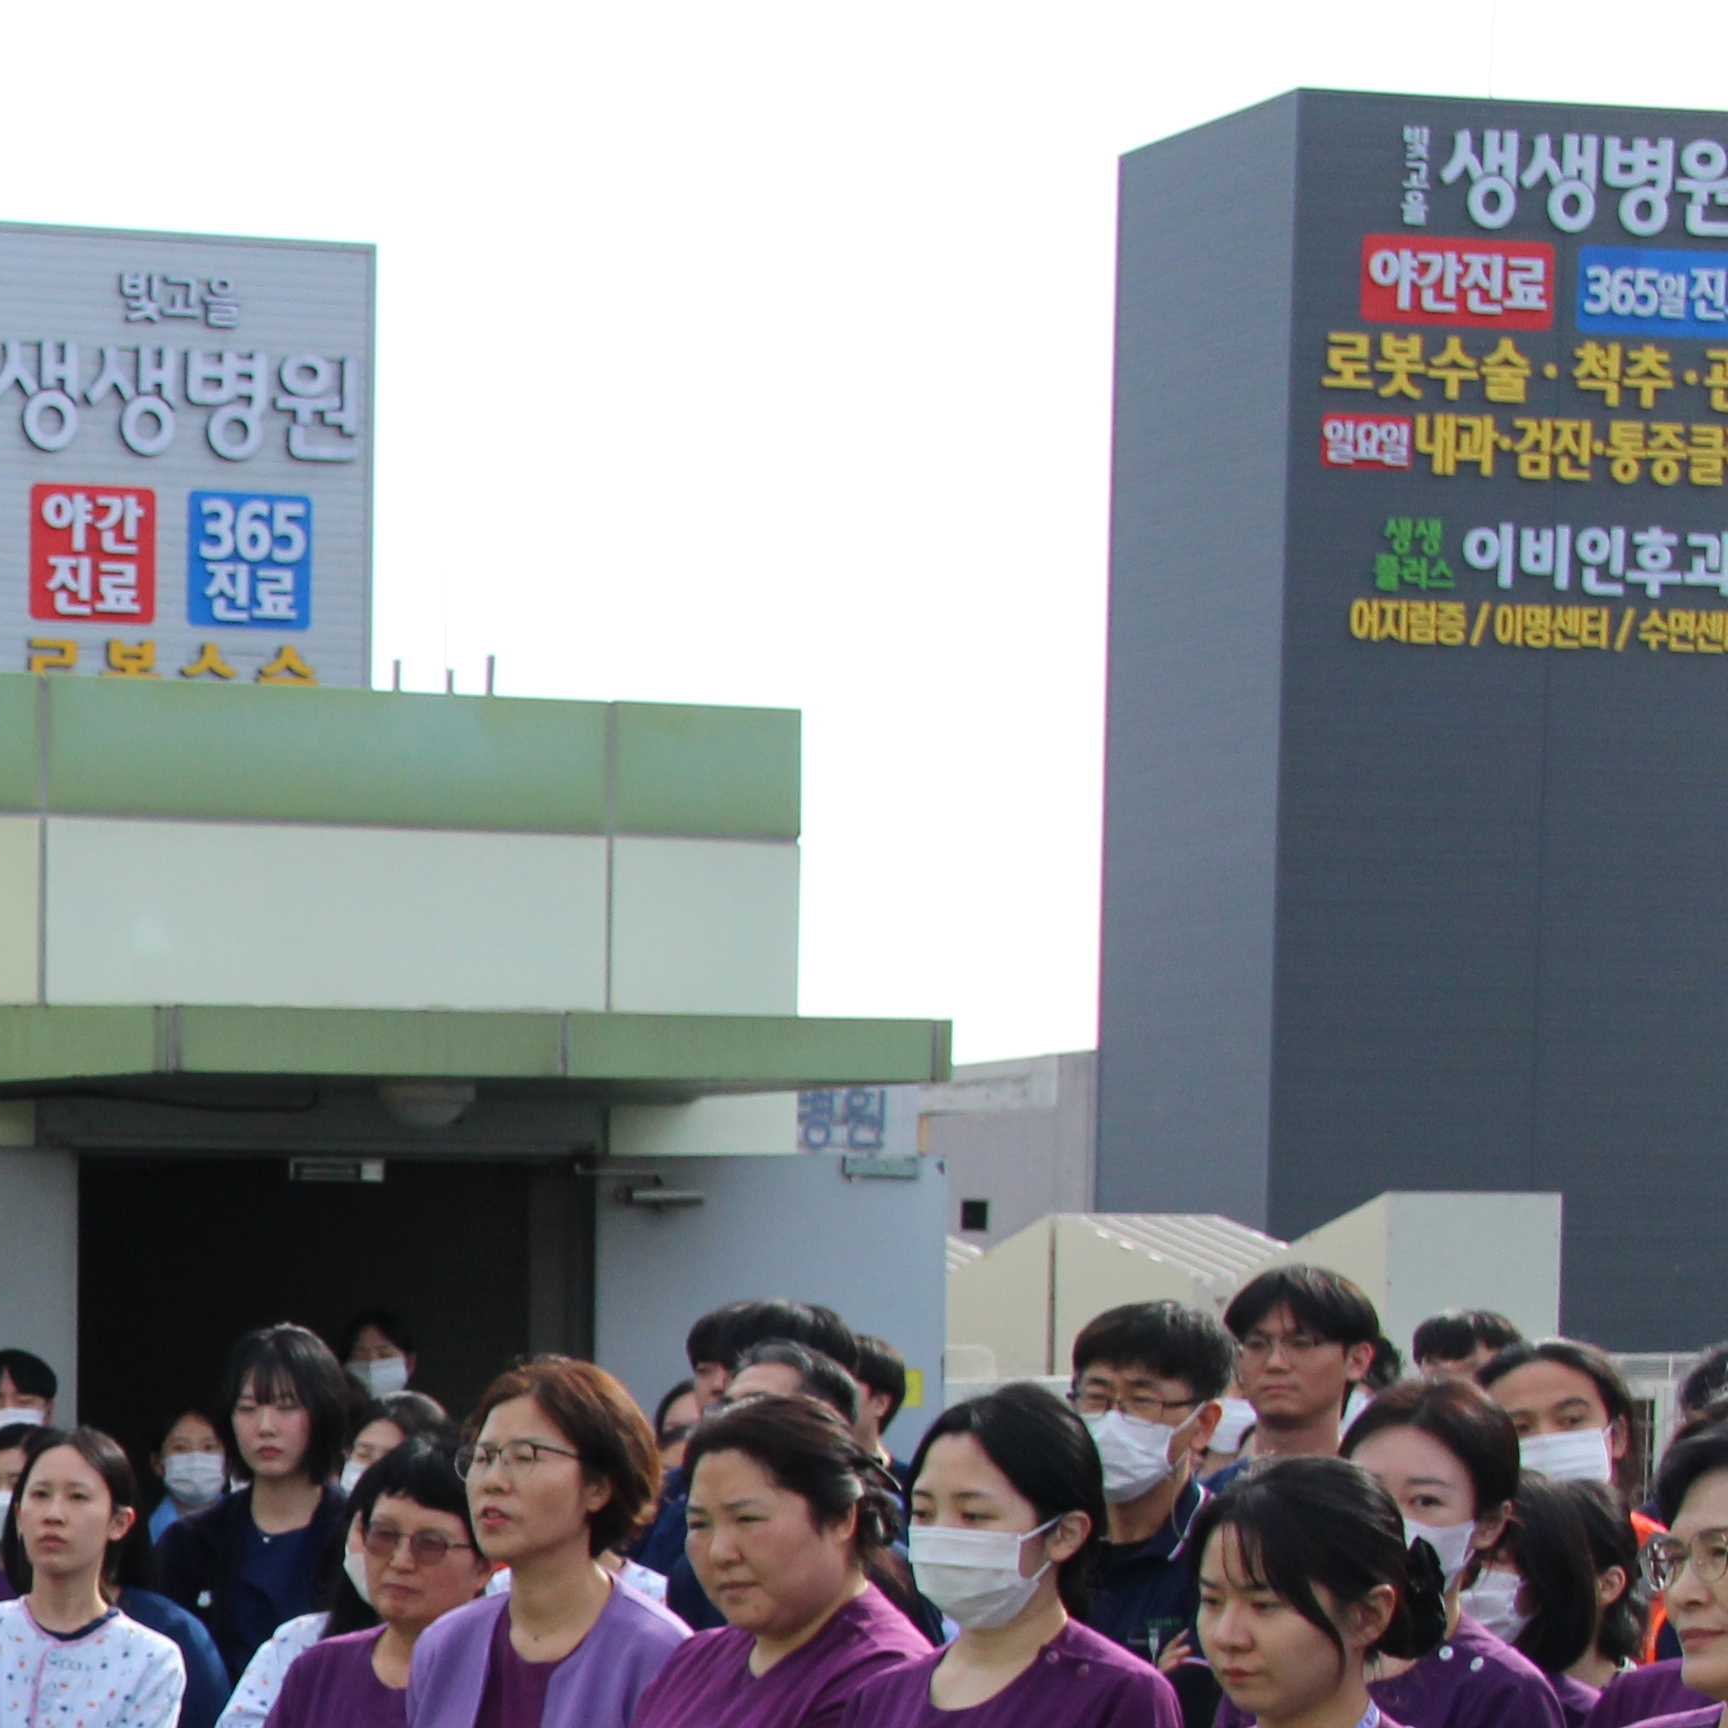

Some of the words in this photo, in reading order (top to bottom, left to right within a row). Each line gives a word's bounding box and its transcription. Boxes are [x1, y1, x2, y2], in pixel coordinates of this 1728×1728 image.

[1439, 128, 1728, 238] 생생병원
[118, 270, 242, 330] 빛고을
[1368, 248, 1547, 316] 야간진료
[1583, 264, 1728, 322] 365일진
[1322, 418, 1411, 467] 일요일
[41, 491, 145, 556] 야간
[198, 497, 307, 564] 365
[1383, 517, 1443, 555] 생생
[45, 555, 143, 617] 진료
[1462, 521, 1728, 599] 이비인후과
[203, 562, 300, 624] 진료
